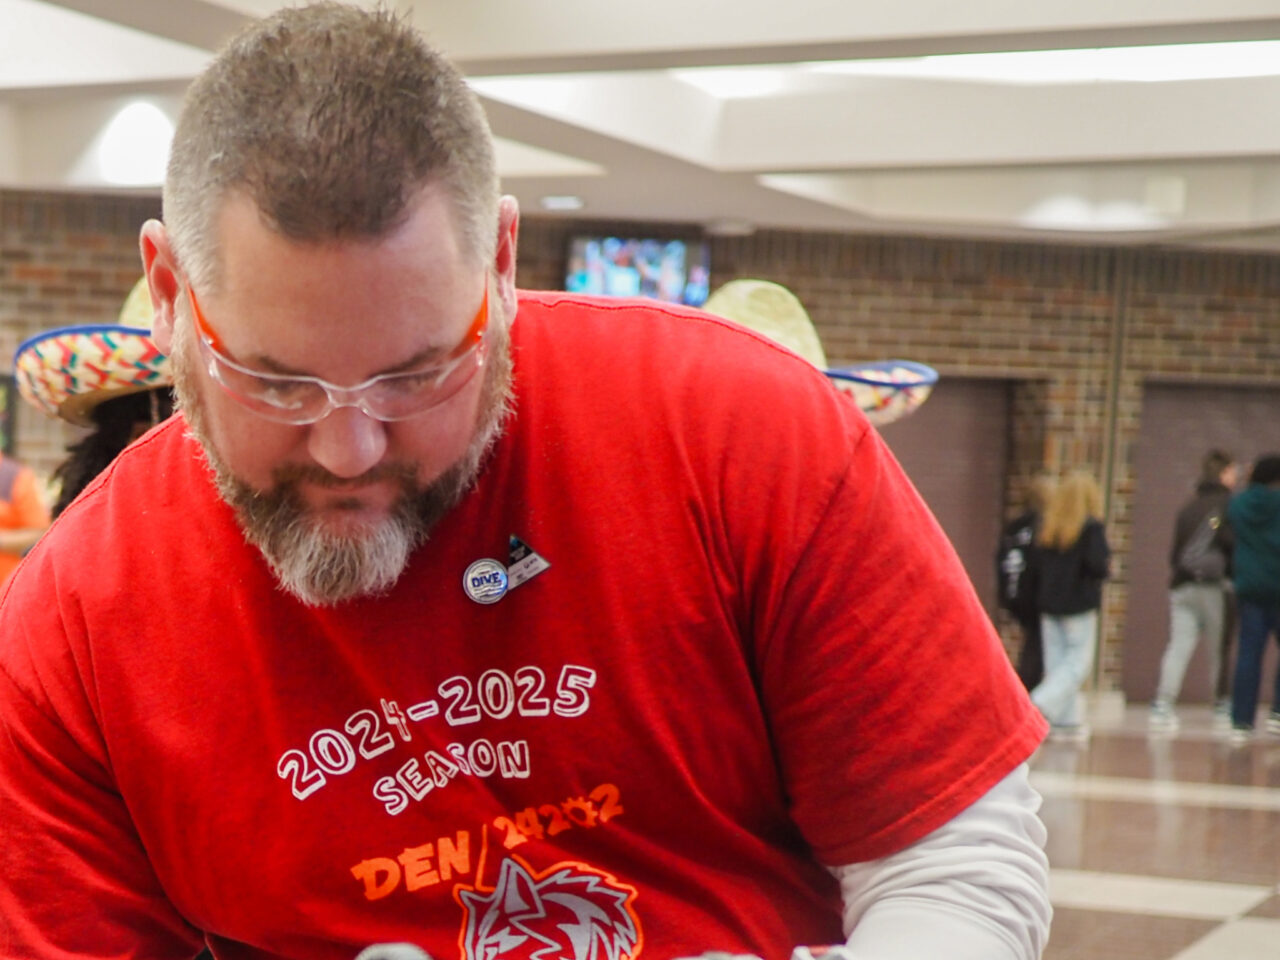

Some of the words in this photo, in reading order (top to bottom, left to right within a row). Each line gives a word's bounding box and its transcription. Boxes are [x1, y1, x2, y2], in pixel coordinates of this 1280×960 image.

[471, 571, 501, 588] DIVE
[277, 664, 597, 801] 2024-2025
[373, 738, 532, 816] SEASON
[350, 830, 470, 901] DEN
[493, 783, 624, 851] 24202
